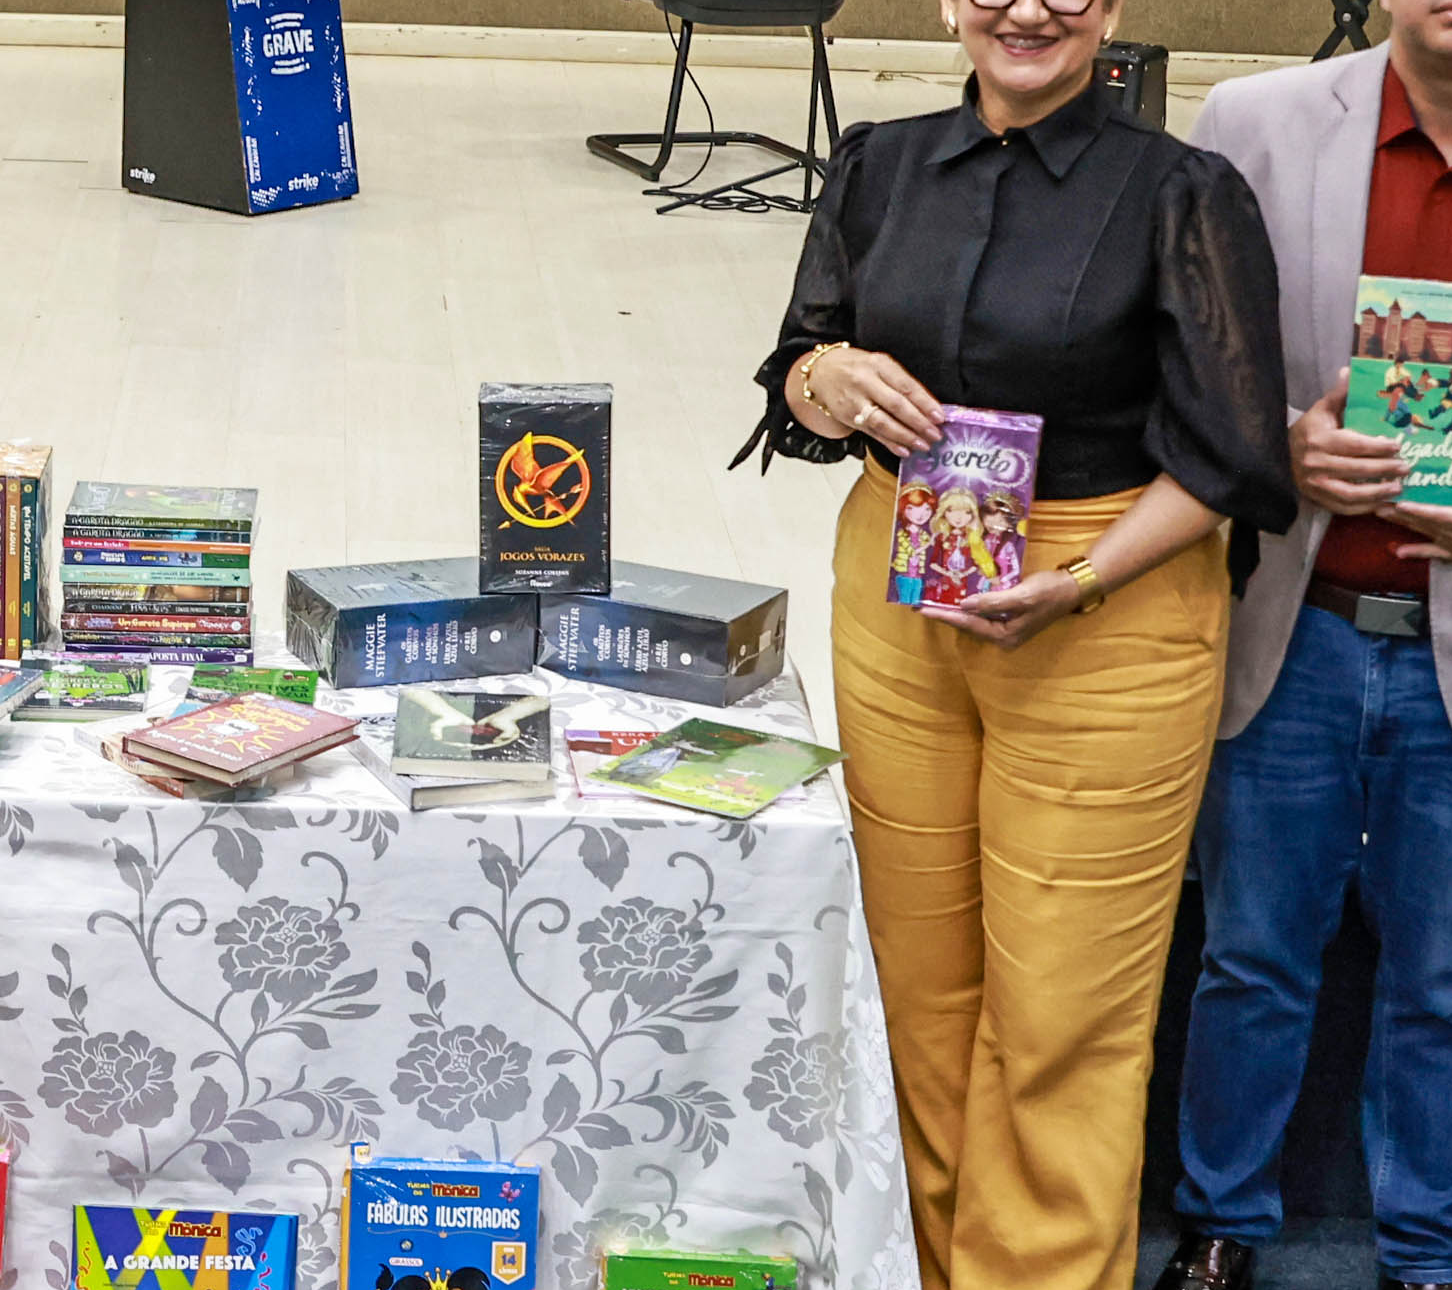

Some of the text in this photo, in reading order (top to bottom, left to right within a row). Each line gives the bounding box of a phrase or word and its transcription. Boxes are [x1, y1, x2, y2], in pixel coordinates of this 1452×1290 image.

[262, 28, 314, 58] GRAVE
[129, 167, 156, 184] strike
[288, 173, 319, 192] strike
[23, 520, 32, 544] TEMPO
[500, 551, 586, 562] JOGOS VORAZES
[132, 618, 160, 627] Garoto
[161, 618, 196, 631] Supimpa
[559, 614, 569, 661] MAGGIE
[365, 623, 376, 671] MAGGIE
[375, 613, 387, 678] STIEFVATER
[470, 626, 478, 654] CORVO
[568, 607, 580, 672] STIEFVATER
[182, 653, 205, 661] FINAL
[661, 640, 669, 668] CORVO
[367, 1199, 521, 1230] FÁBULAS ILUSTRADAS
[104, 1255, 256, 1270] A GRANDE FESTA
[501, 1254, 517, 1265] 14
